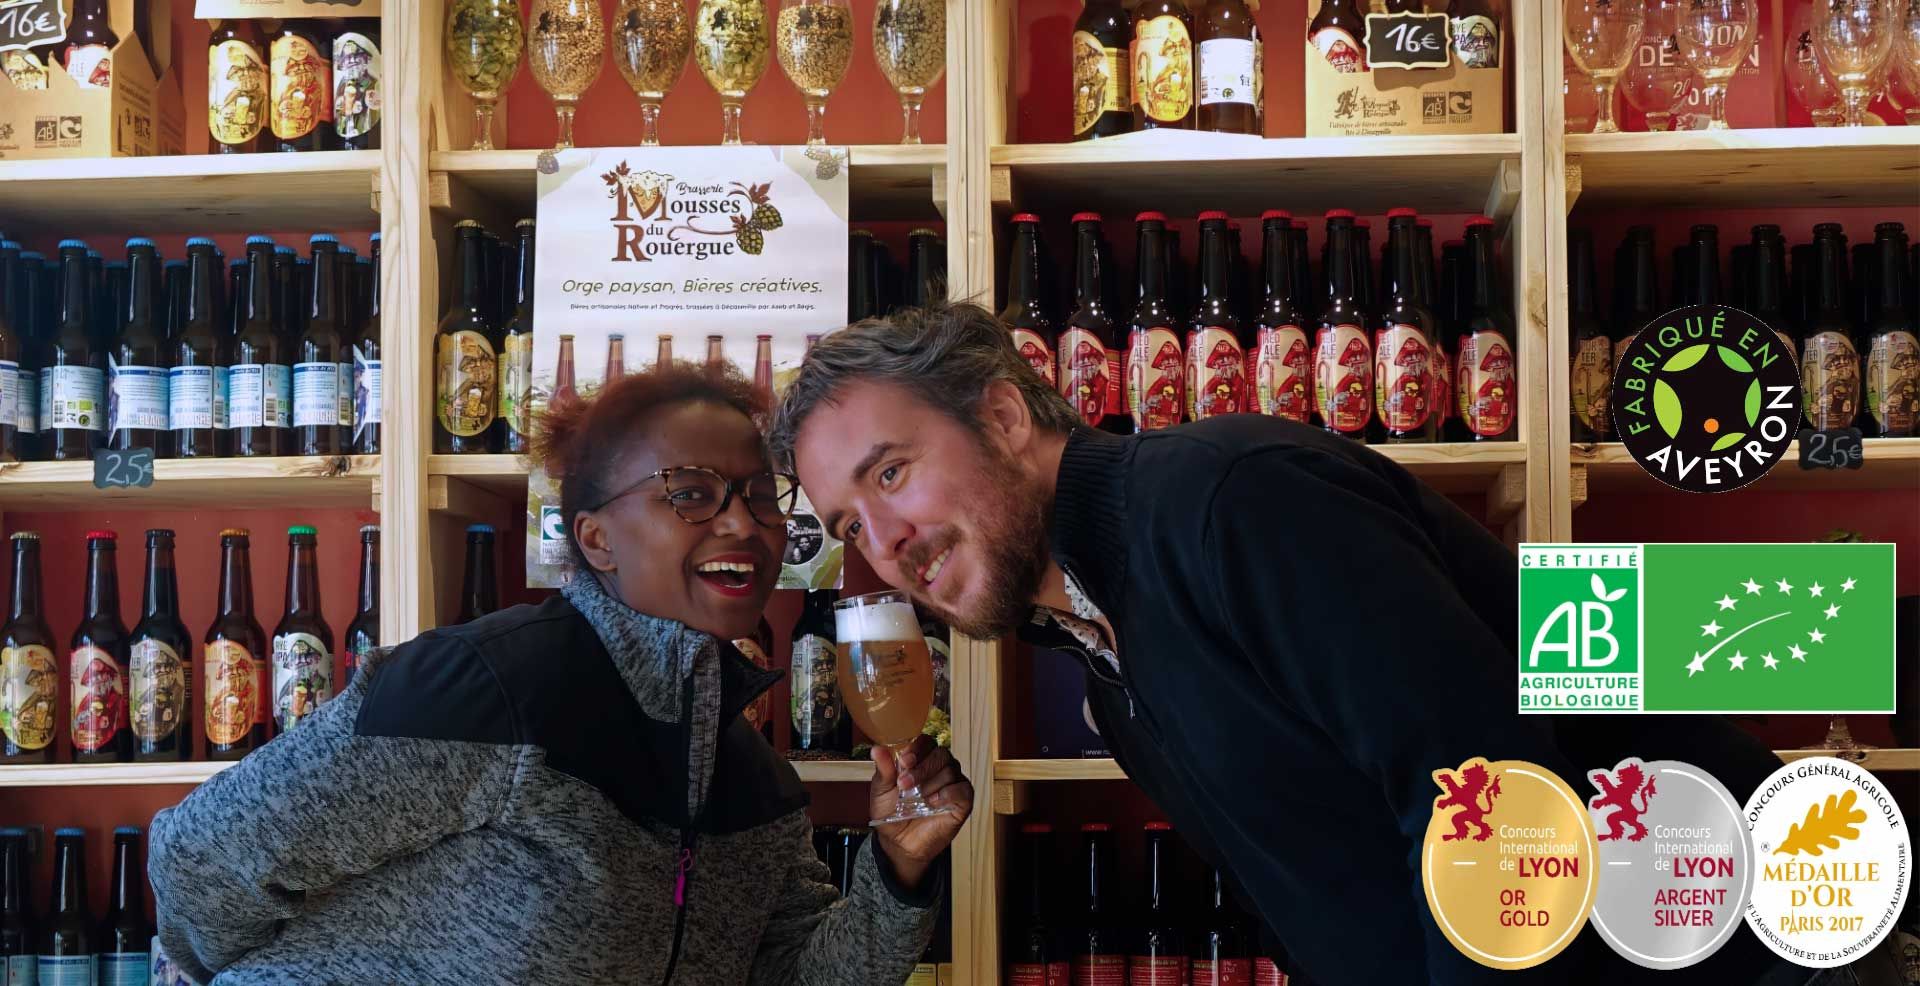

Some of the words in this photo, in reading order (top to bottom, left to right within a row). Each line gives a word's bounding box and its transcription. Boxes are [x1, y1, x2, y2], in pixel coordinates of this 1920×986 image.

[0, 5, 56, 38] 16€
[1385, 23, 1440, 52] 16€
[1424, 102, 1443, 116] AB
[611, 172, 741, 222] Mousses
[676, 182, 724, 195] Brasserie
[646, 224, 664, 236] du
[612, 224, 735, 262] Rouergue
[562, 280, 604, 296] Orge
[609, 281, 676, 296] paysan,
[683, 277, 733, 293] Bières
[740, 276, 823, 293] créatives.
[1263, 333, 1280, 344] RED
[1264, 345, 1281, 356] ALE
